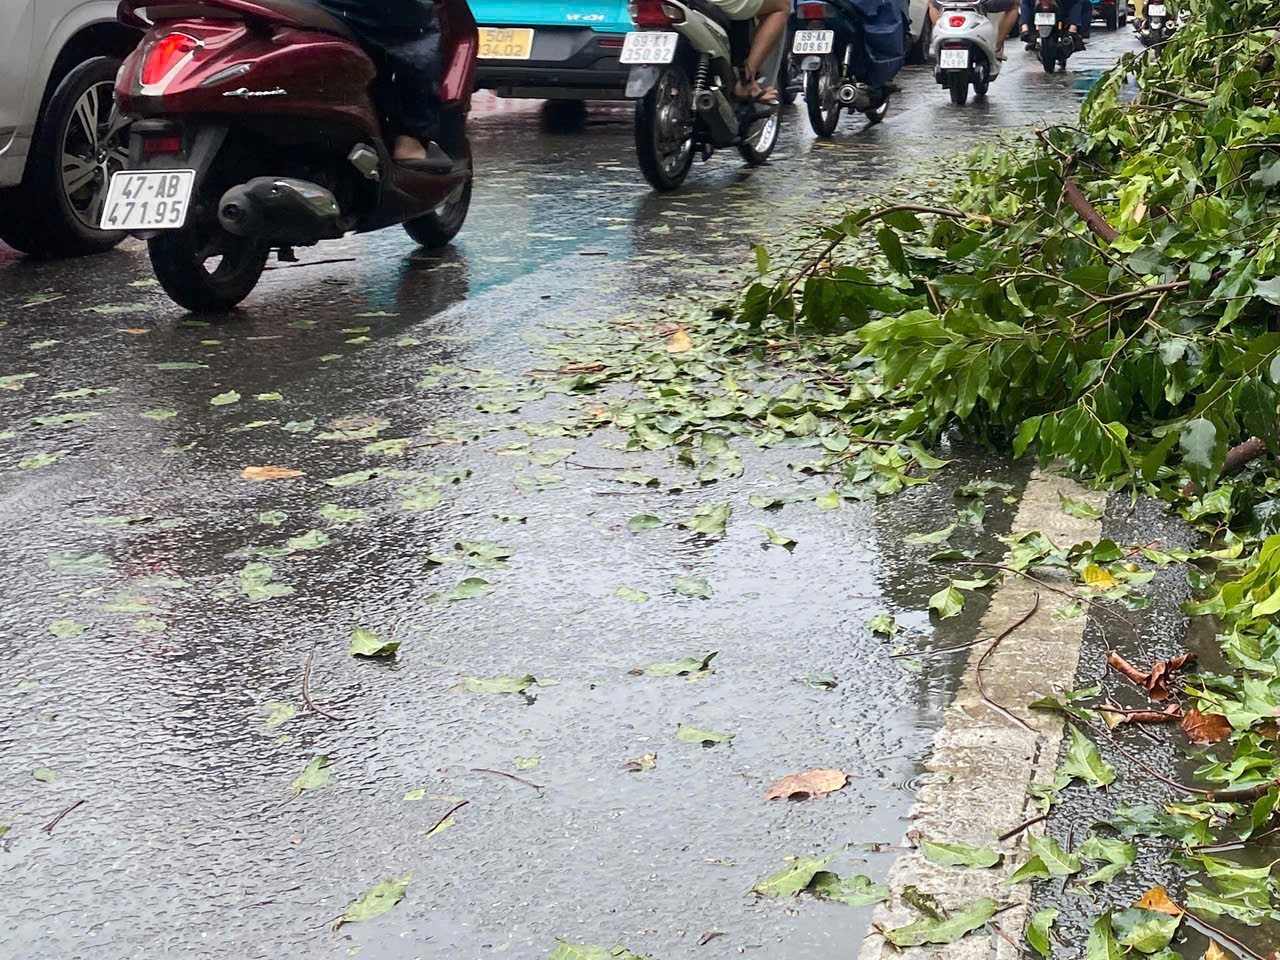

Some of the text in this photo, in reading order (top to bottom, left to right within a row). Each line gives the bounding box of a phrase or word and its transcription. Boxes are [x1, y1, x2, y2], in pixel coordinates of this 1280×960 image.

[632, 34, 668, 49] 69-K1
[801, 31, 827, 41] 69-AA
[796, 41, 829, 52] 009.61
[624, 48, 670, 61] 350.82
[122, 174, 180, 200] 47-AB
[108, 200, 182, 226] 471.95
